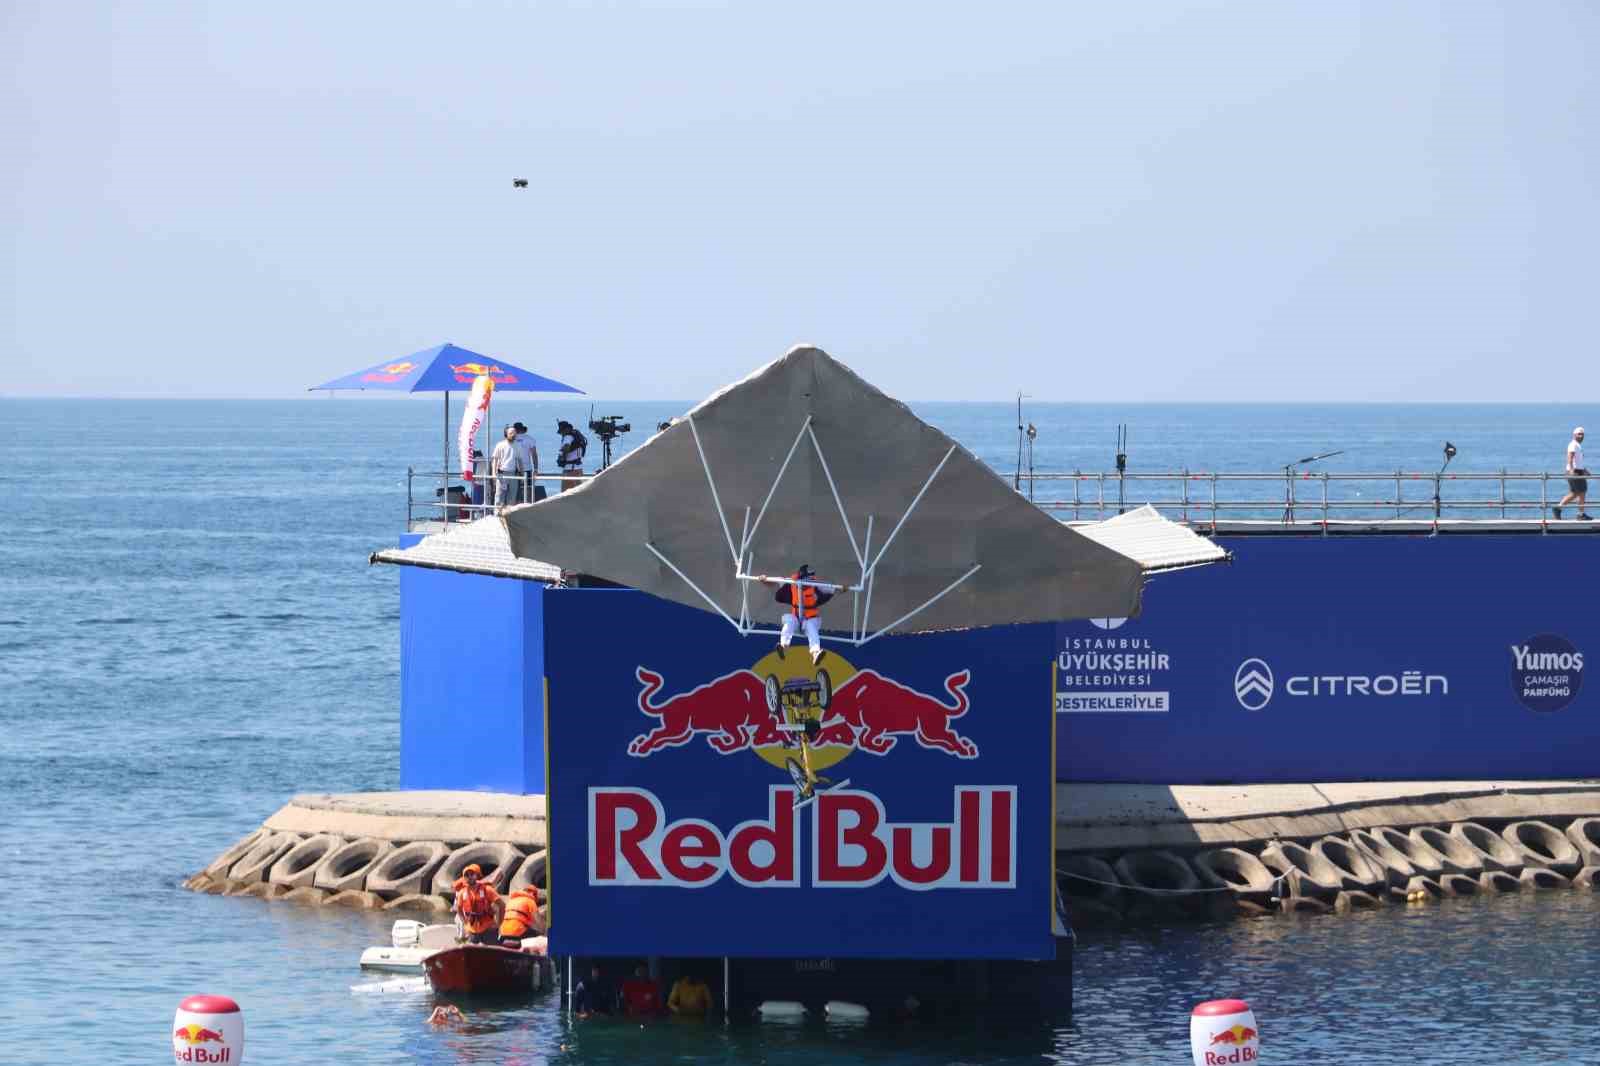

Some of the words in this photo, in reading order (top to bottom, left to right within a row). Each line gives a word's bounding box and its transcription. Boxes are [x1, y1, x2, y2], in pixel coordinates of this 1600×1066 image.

[1065, 636, 1151, 649] İSTANBUL
[1056, 651, 1170, 671] ÜYÜKŞEHİR
[1511, 645, 1584, 672] Yumoş
[1065, 673, 1151, 685] BELEDİYESİ
[1286, 671, 1448, 695] CITROËN
[1524, 675, 1569, 686] ÇAMAŞIR
[1523, 686, 1570, 696] PARFÜMÜ
[588, 784, 801, 888] Red
[811, 785, 1017, 890] Bull
[195, 1047, 230, 1063] Bull
[1205, 1048, 1240, 1065] Red
